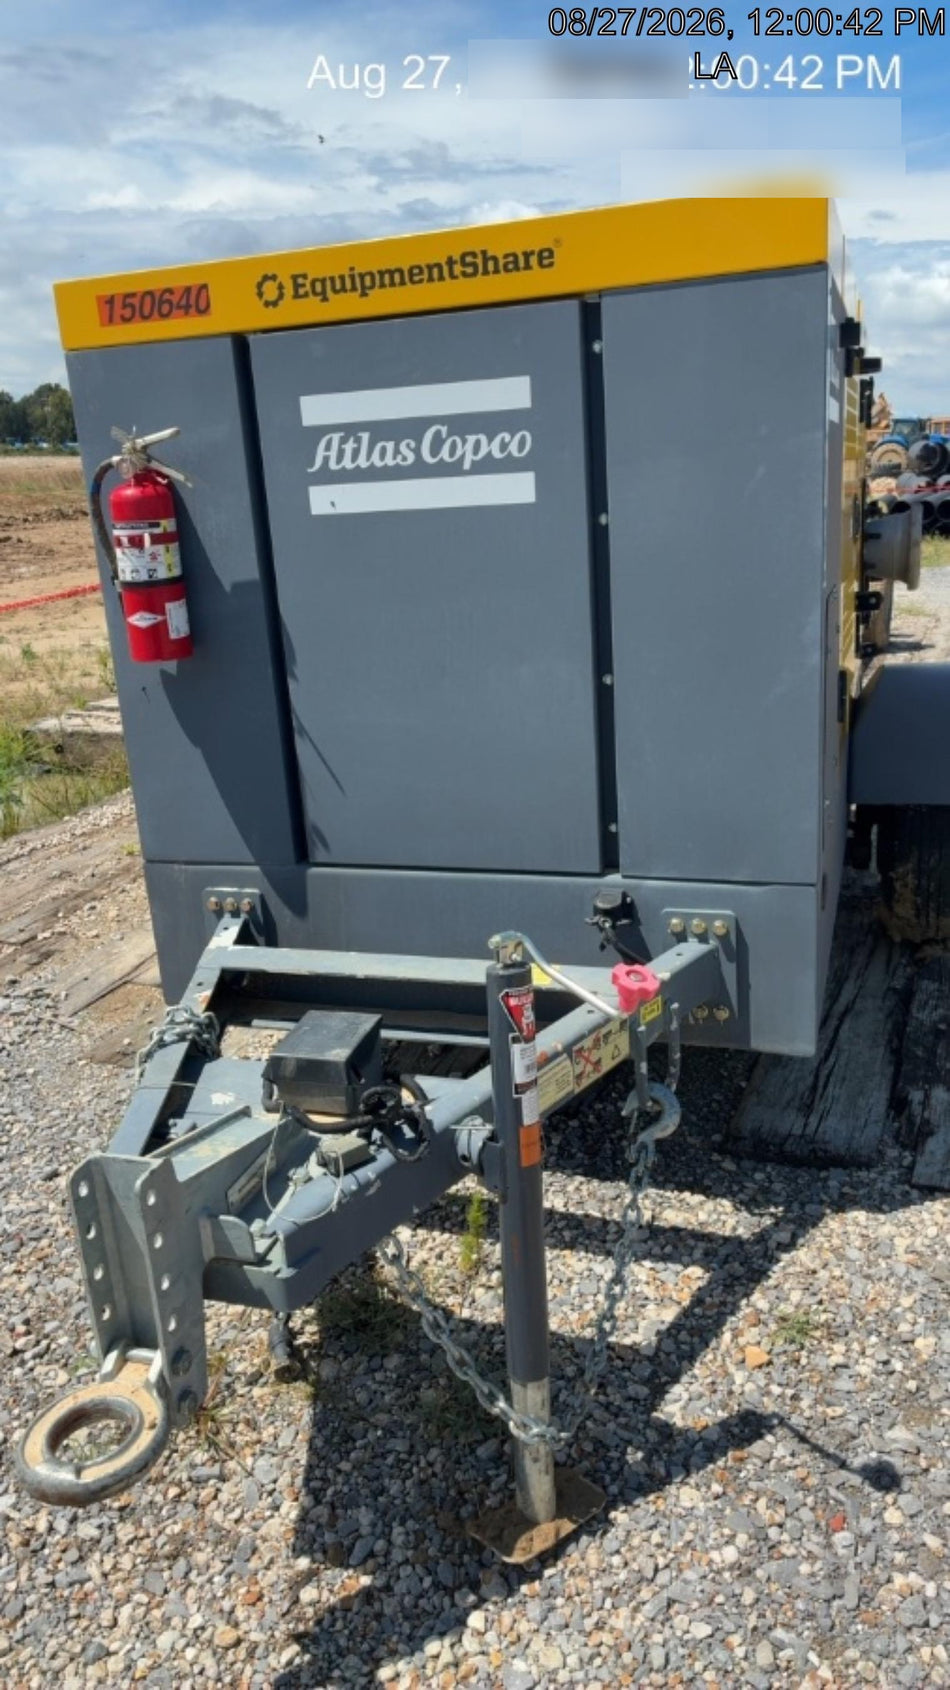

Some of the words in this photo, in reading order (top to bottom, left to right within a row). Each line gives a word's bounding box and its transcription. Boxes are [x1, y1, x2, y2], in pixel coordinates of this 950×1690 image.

[291, 247, 555, 302] EquipmentShare
[104, 283, 211, 324] 150640
[307, 431, 416, 473] Atlas
[420, 424, 532, 470] Copco
